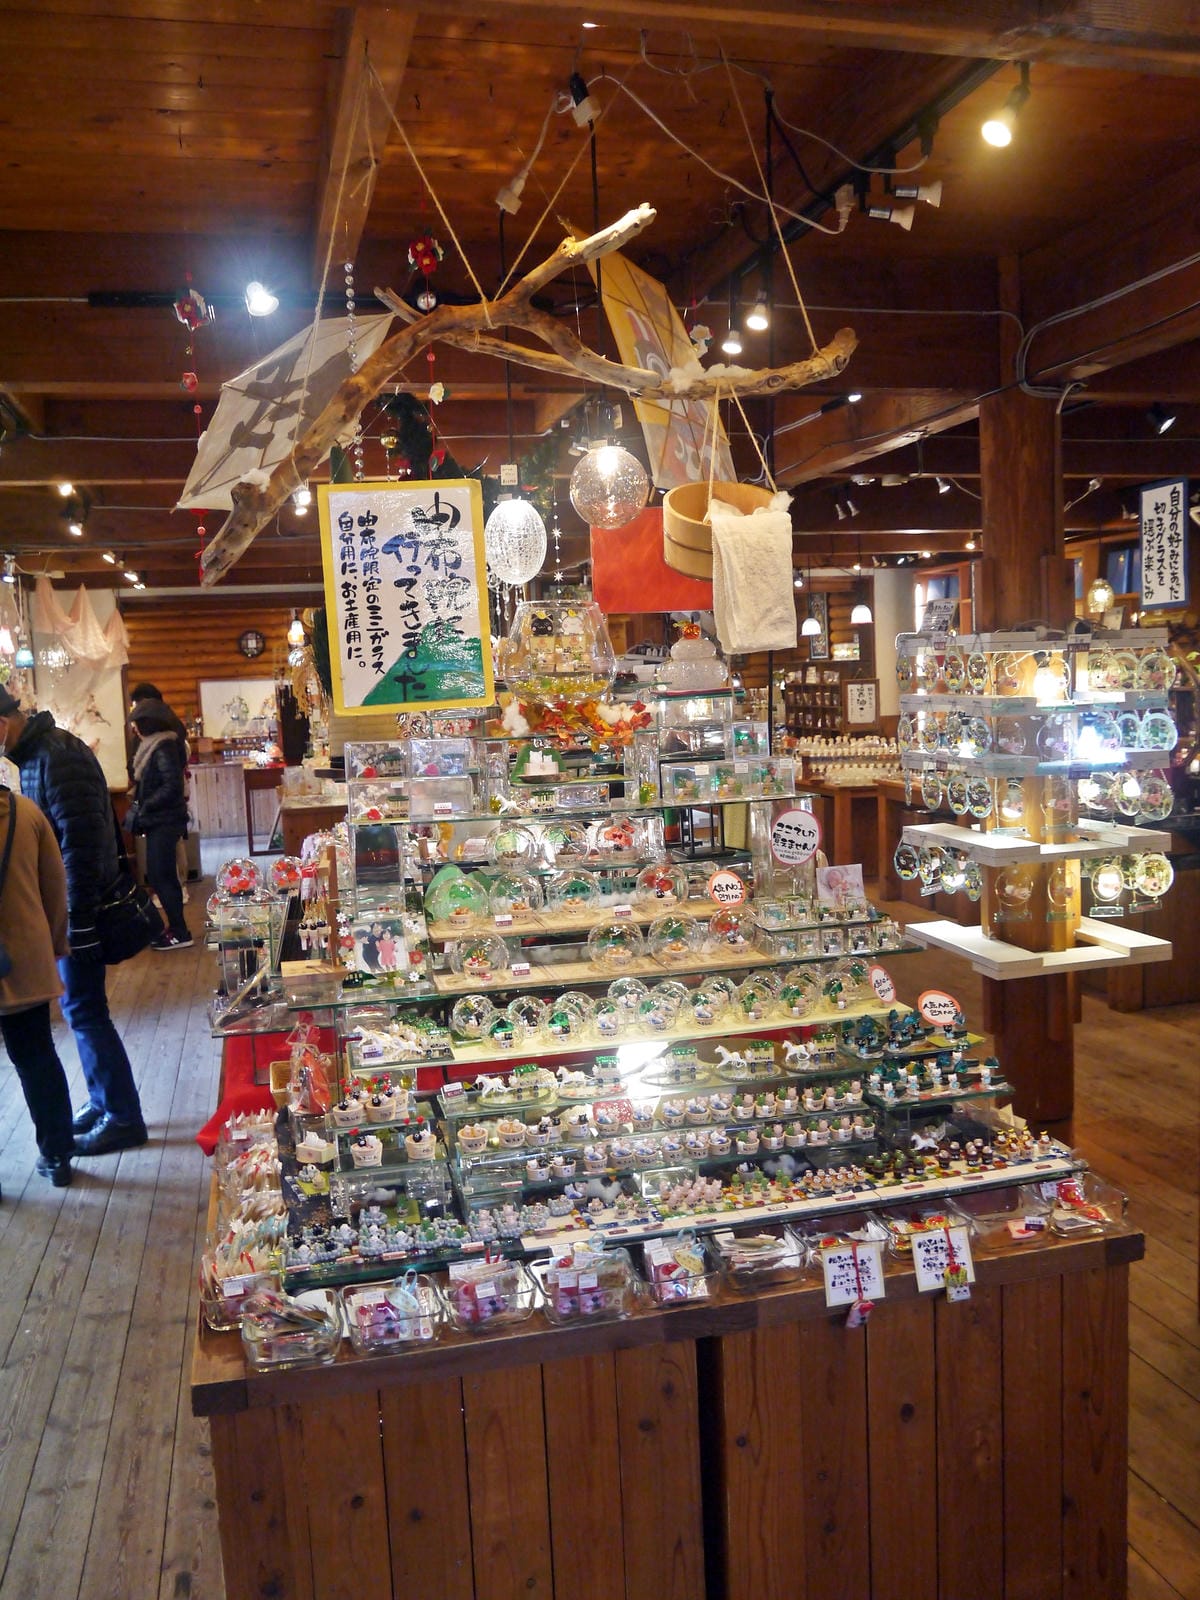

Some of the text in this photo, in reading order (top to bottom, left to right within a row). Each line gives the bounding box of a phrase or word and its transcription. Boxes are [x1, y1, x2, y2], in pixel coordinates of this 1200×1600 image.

[1143, 518, 1156, 600] 選ぶ楽しみ
[1154, 502, 1167, 586] 切子グラスを
[357, 510, 389, 674] 由布院限定のミニガラス
[381, 531, 430, 701] 行ってきました
[776, 822, 817, 838] ここでしか
